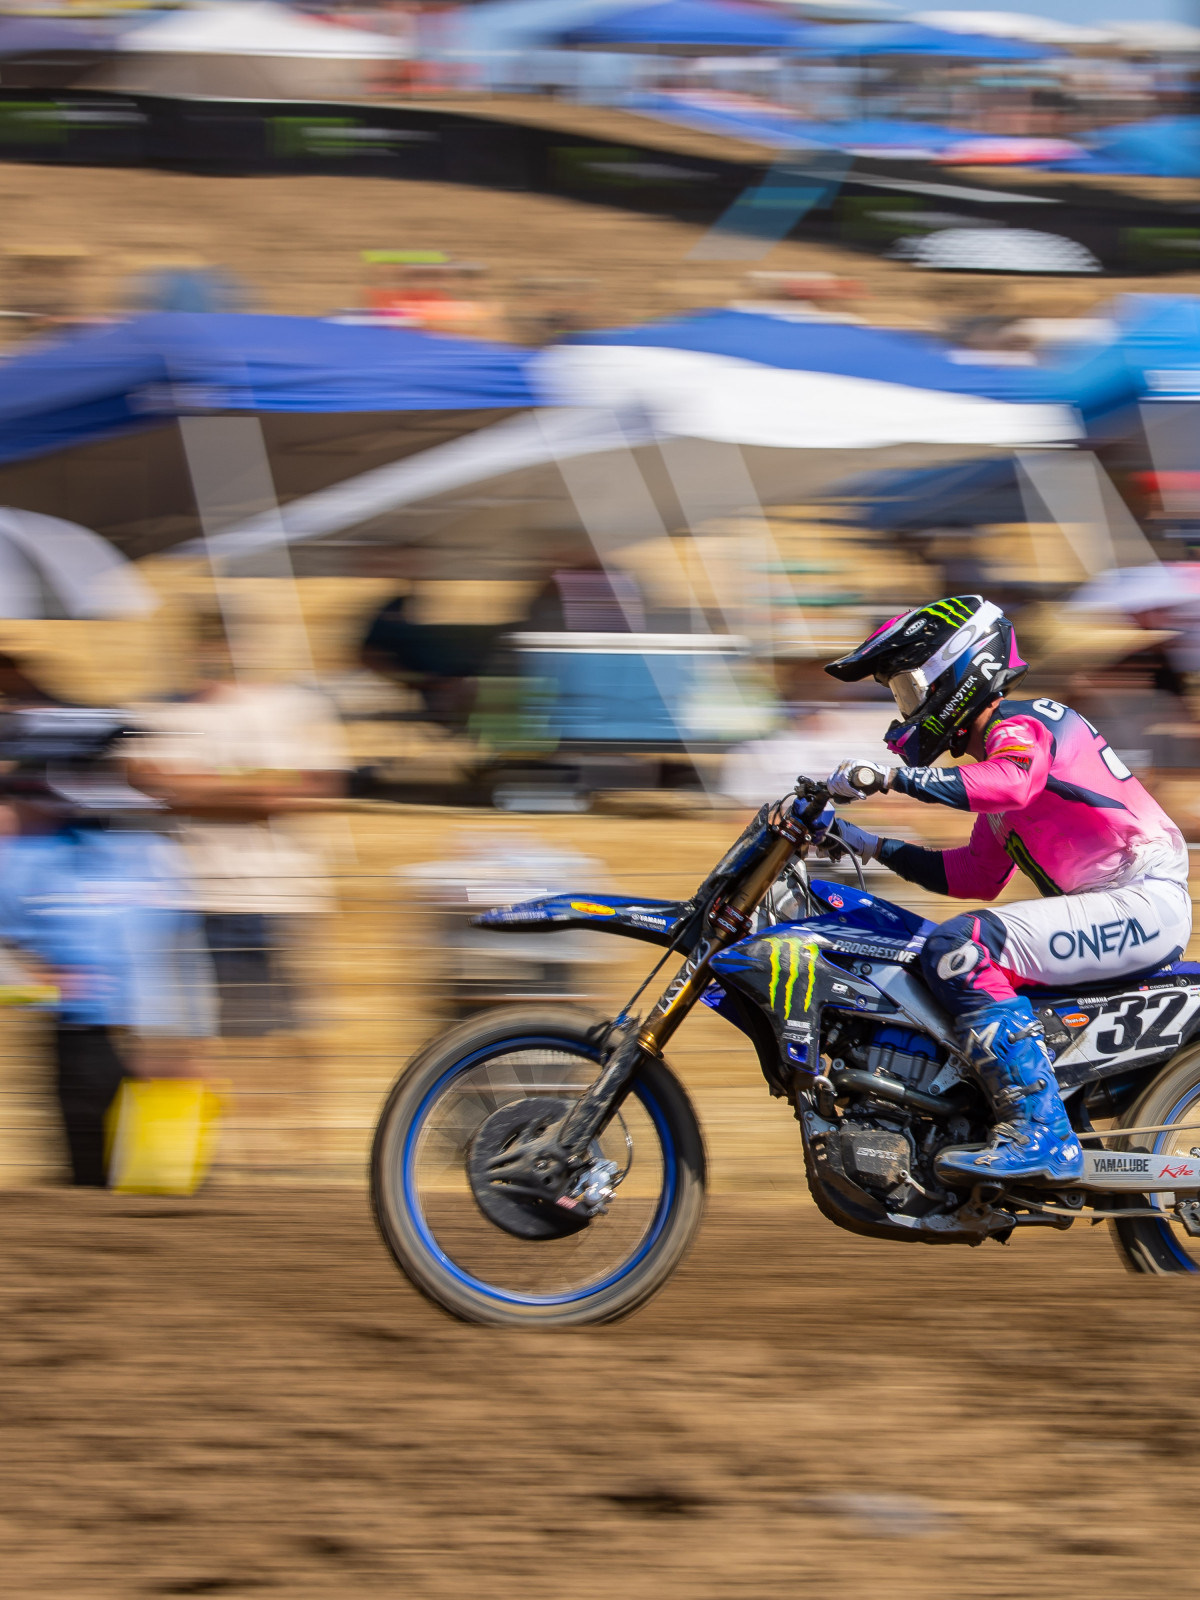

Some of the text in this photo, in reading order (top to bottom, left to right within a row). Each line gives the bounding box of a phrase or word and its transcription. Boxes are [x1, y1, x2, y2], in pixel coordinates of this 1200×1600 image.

[939, 675, 978, 720] MONSTER
[640, 914, 667, 926] YAMAHA
[832, 939, 917, 963] PROGRESSIVE
[1084, 996, 1109, 1005] YAMAHA
[1095, 991, 1188, 1055] 32
[1093, 1158, 1150, 1172] YAMALUBE
[1158, 1164, 1194, 1178] Kite
